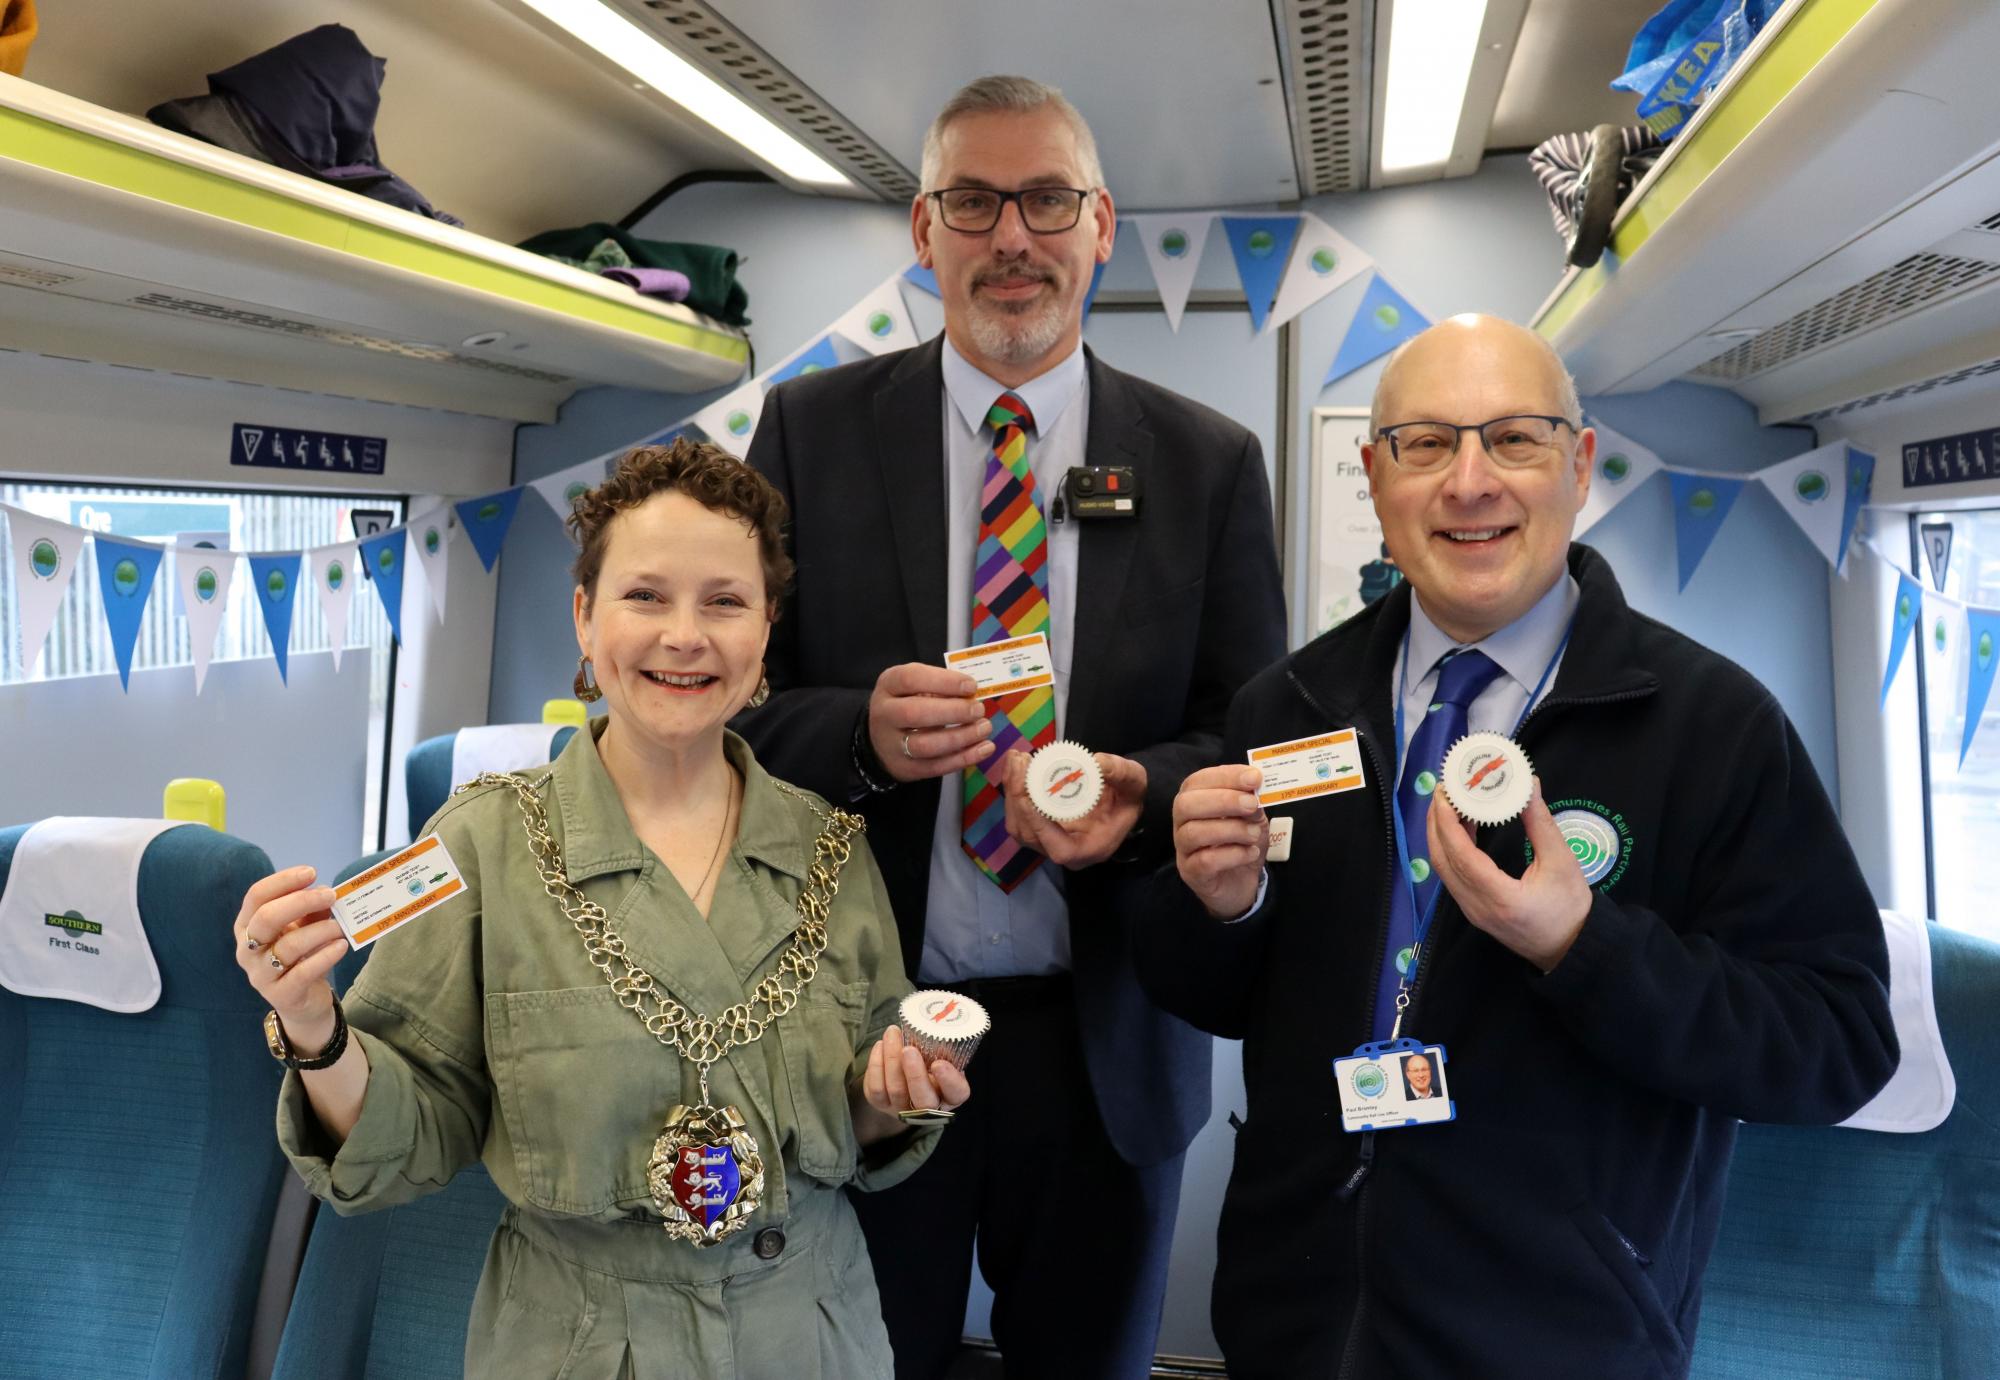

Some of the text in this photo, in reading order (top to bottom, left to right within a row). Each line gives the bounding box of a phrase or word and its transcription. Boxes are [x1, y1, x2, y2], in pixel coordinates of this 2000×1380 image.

[1648, 41, 1722, 108] KEA
[79, 505, 112, 532] Ore
[1307, 738, 1332, 747] SPECIAL
[1297, 783, 1338, 795] ANNIVERSARY
[1612, 814, 1630, 836] Rail
[350, 850, 416, 887] MARSHLINK SPECIAL
[48, 916, 100, 933] SOUTHERN
[49, 937, 100, 955] First Class
